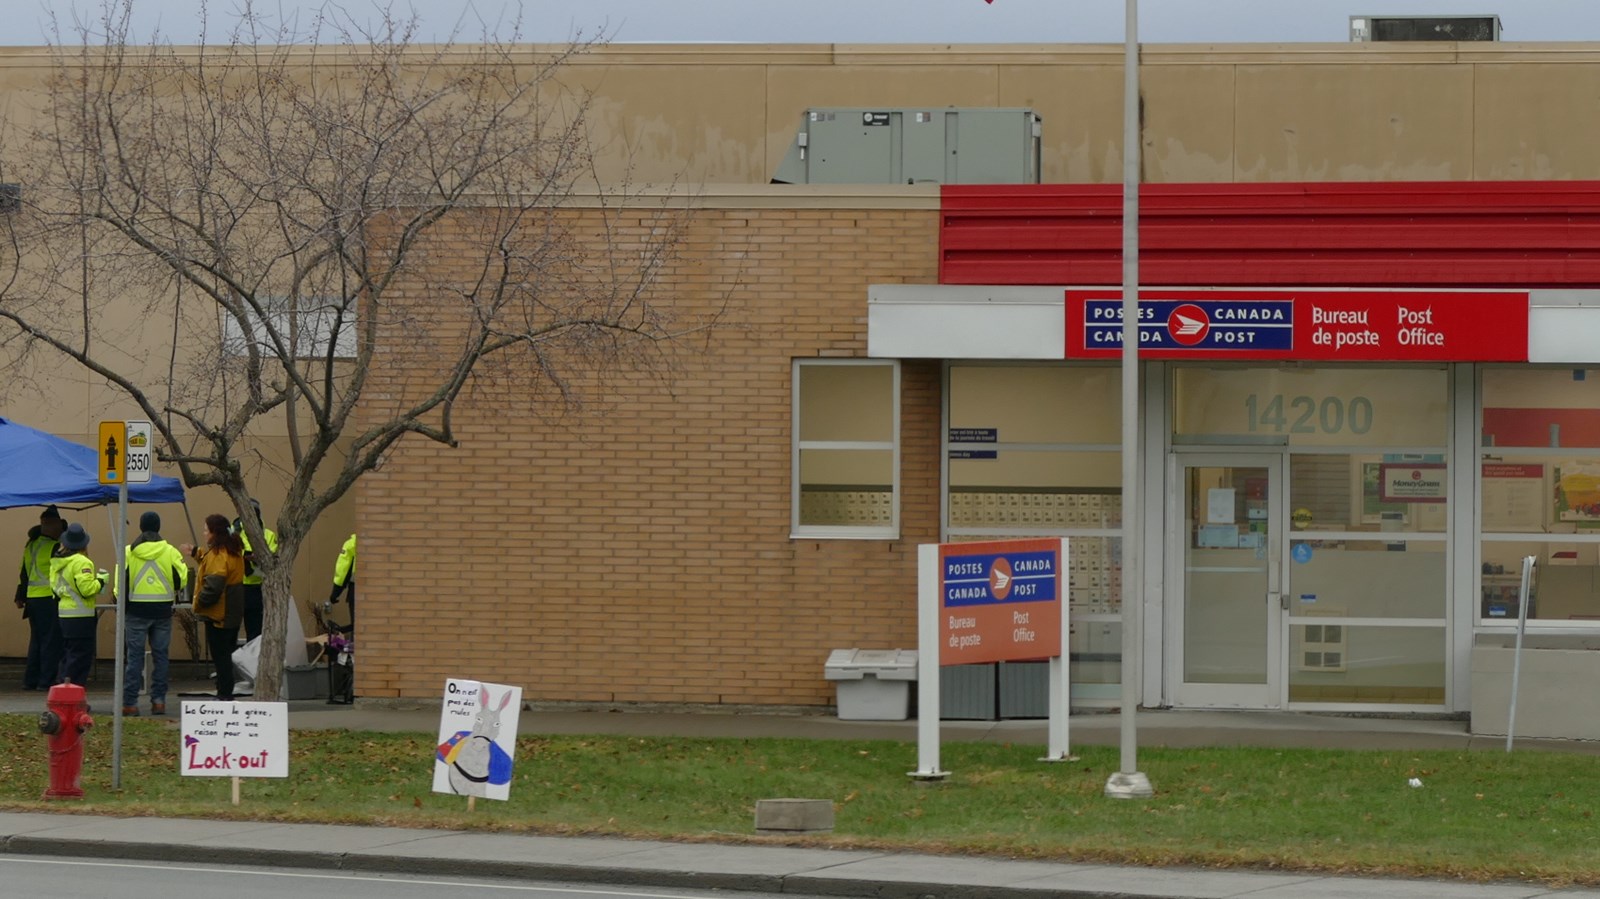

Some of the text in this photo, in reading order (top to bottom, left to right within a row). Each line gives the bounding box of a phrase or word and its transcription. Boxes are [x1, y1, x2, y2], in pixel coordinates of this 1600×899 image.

[1094, 307, 1284, 320] POSES CANADA
[1312, 305, 1432, 324] Bureau Post
[1094, 331, 1256, 343] CANDA POST
[1312, 328, 1444, 350] de poste Office
[1245, 394, 1373, 434] 14200
[1392, 479, 1440, 488] MoneyGram
[948, 559, 1051, 575] POSTES CANADA
[948, 584, 1036, 600] CANADA POST
[949, 611, 1029, 630] Bureau Post
[949, 628, 1035, 650] de poste Office
[448, 682, 461, 695] On
[447, 698, 475, 707] pas des
[223, 731, 241, 739] pour
[188, 743, 268, 770] Lock-out
